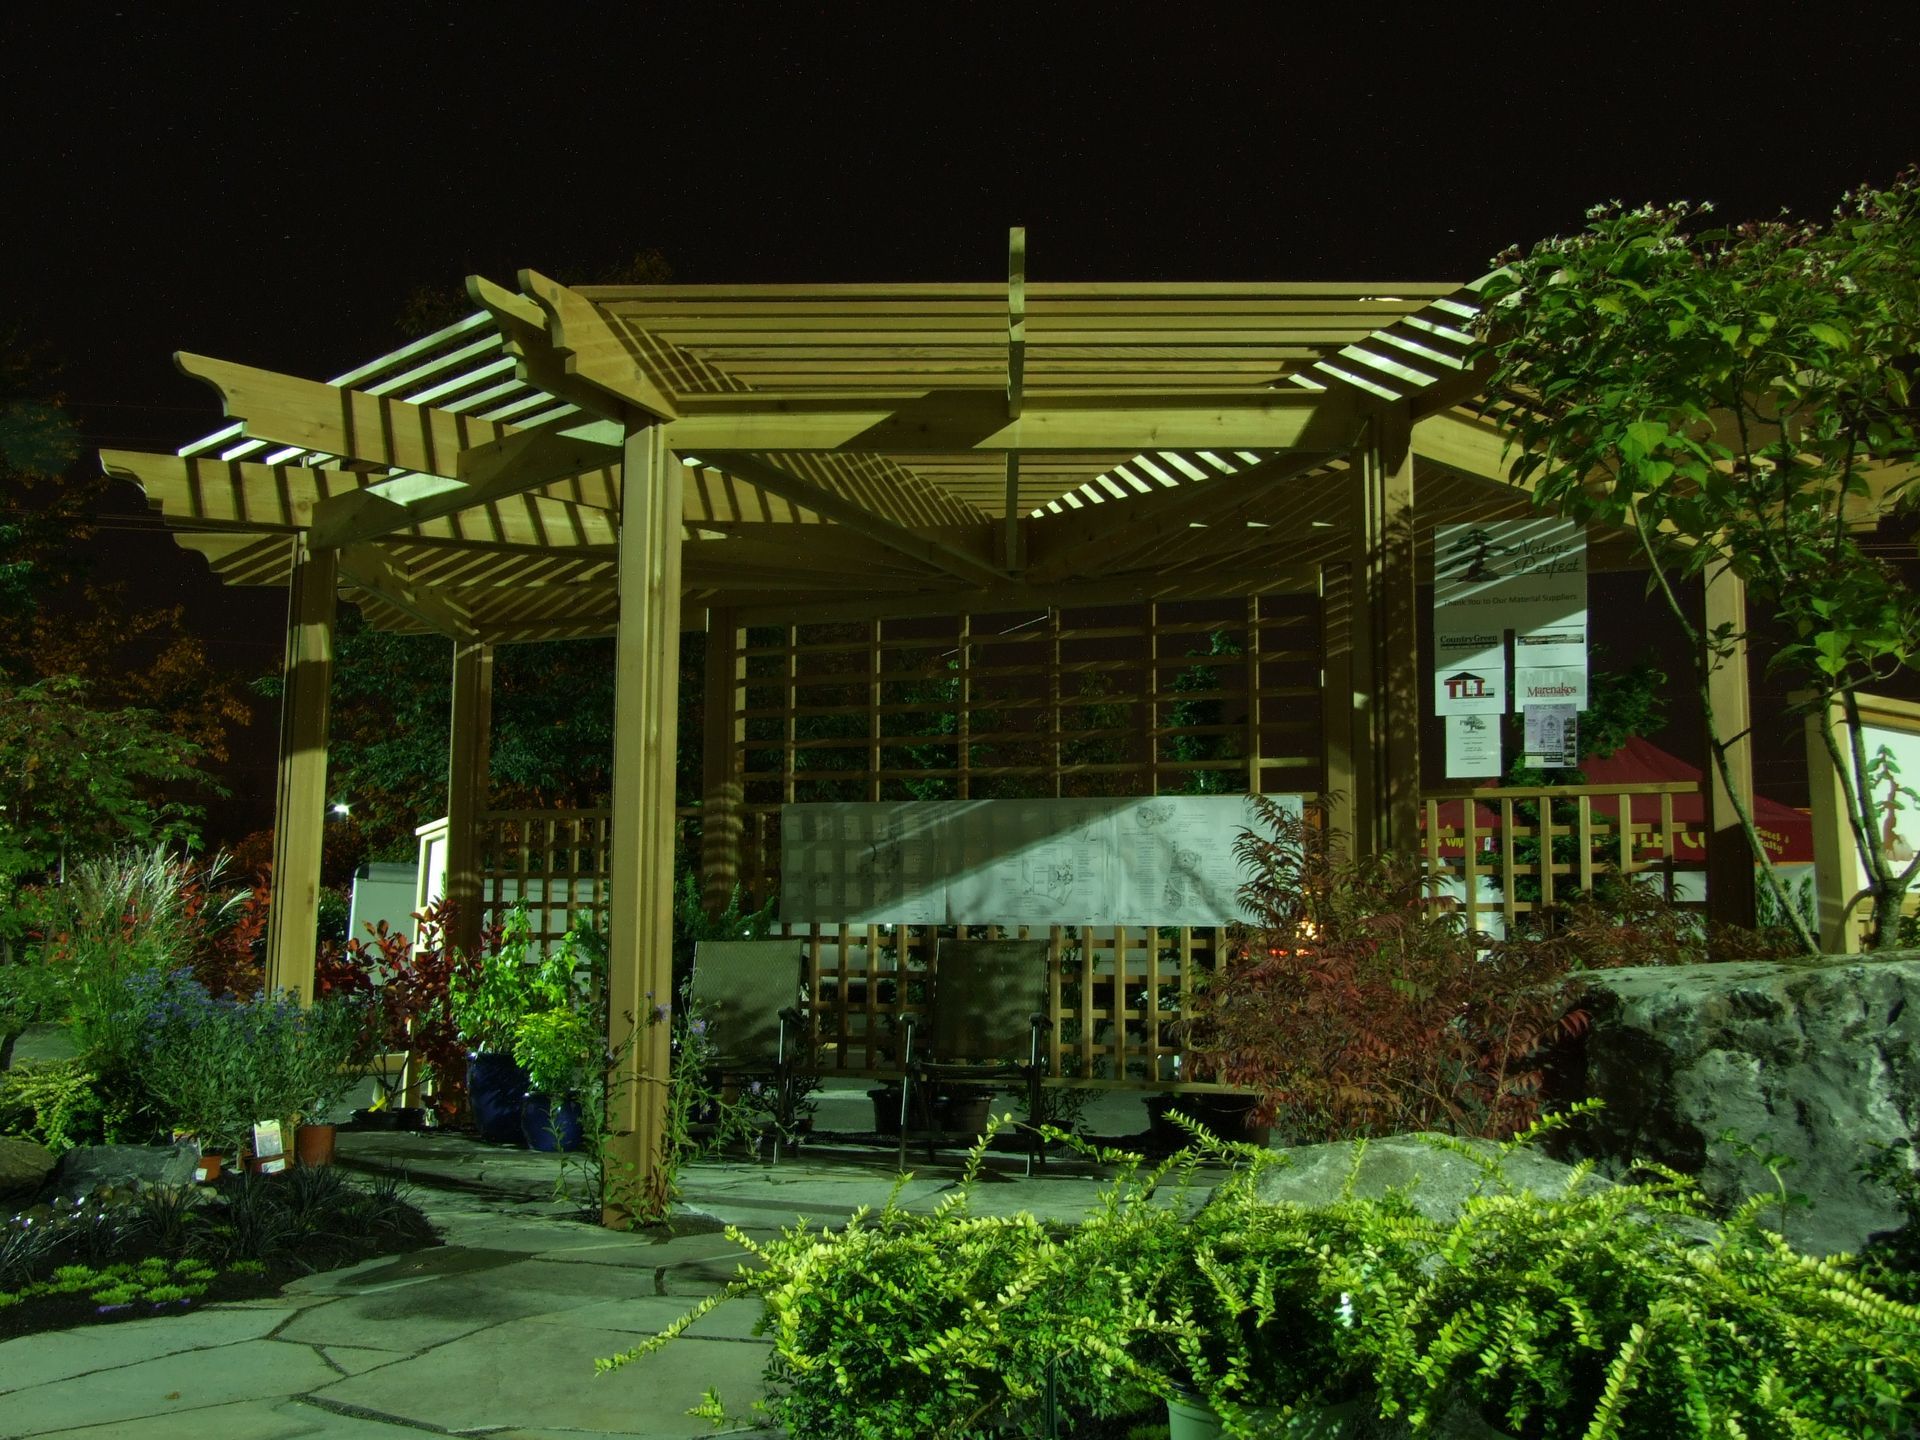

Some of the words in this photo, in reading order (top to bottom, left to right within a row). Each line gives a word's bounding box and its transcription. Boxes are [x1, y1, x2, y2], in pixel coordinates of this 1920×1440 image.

[1505, 539, 1571, 556] Nature
[1514, 554, 1579, 579] Perfect
[1468, 598, 1481, 606] You
[1492, 597, 1506, 605] Our
[1508, 594, 1540, 604] Material
[1542, 593, 1577, 603] Suppliers
[1527, 682, 1577, 698] Marenakos
